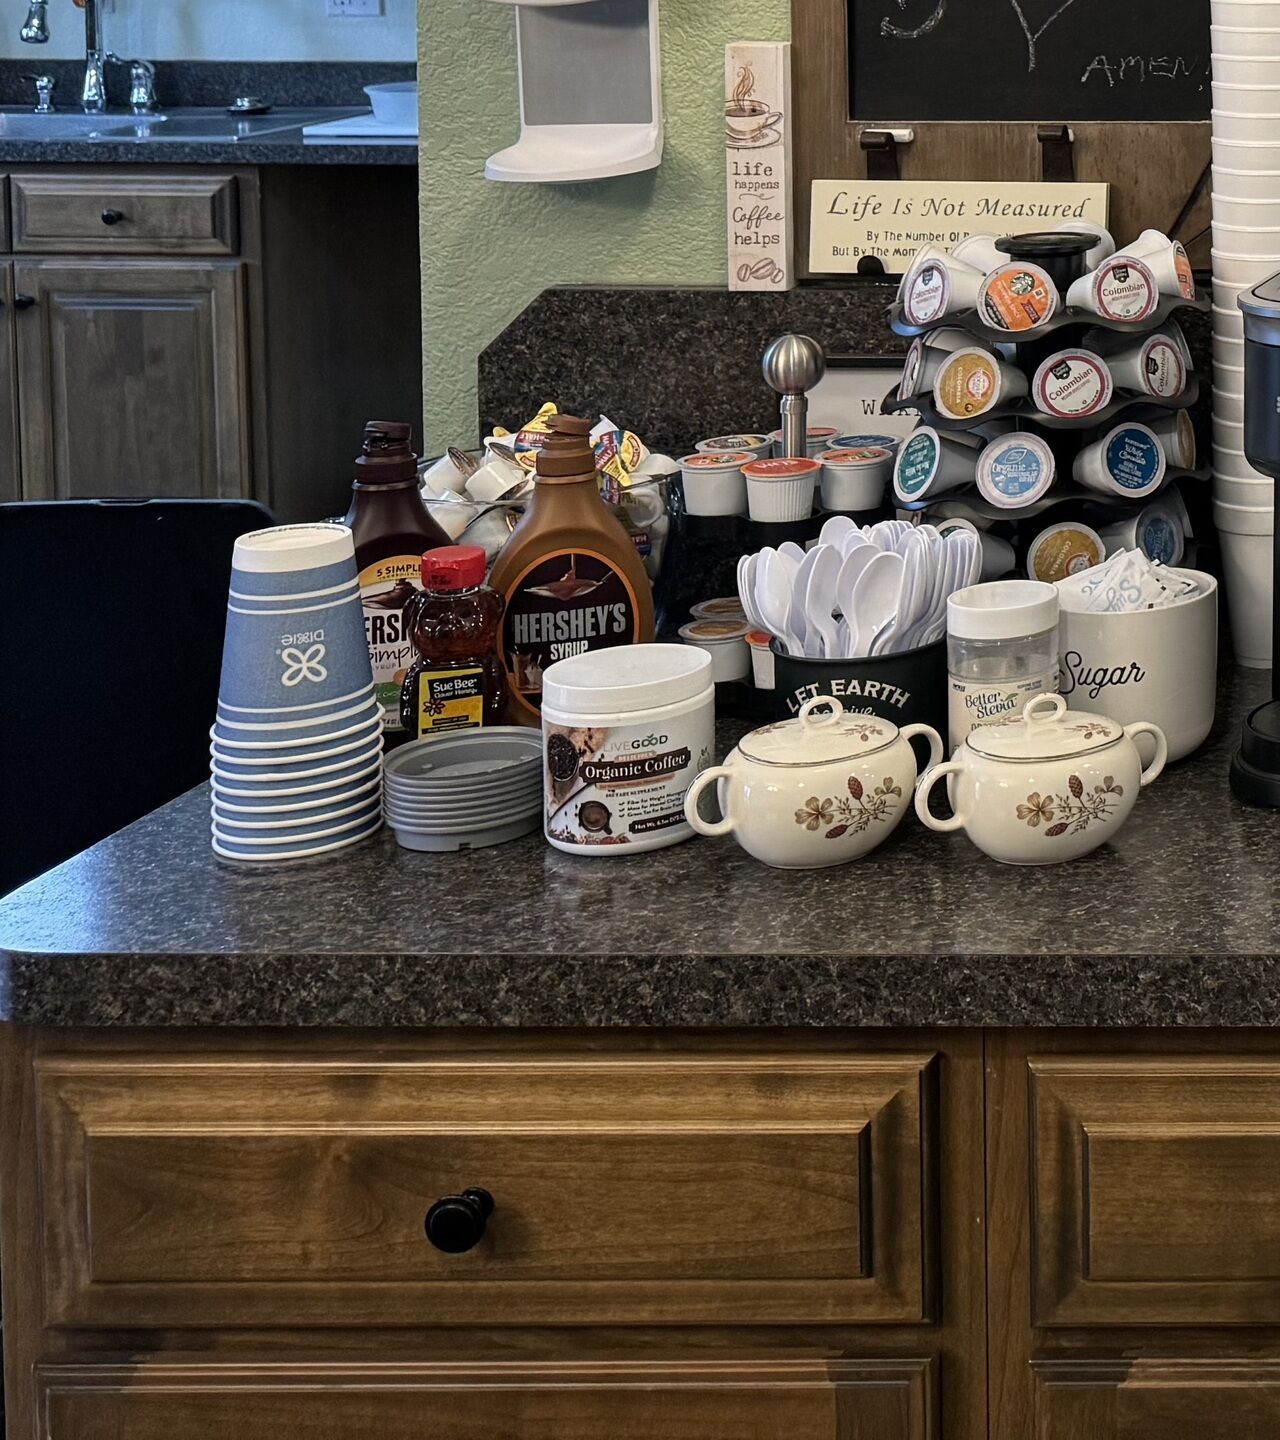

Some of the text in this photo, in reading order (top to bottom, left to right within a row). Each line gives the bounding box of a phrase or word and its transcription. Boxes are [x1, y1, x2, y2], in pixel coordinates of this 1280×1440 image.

[732, 161, 773, 177] life
[734, 179, 780, 191] happens
[826, 191, 1091, 221] Life Is Not Measured
[732, 205, 785, 230] Coffee
[734, 232, 780, 248] helps
[866, 230, 880, 244] By
[884, 230, 903, 241] The
[905, 231, 945, 242] Number
[949, 232, 960, 242] Of
[832, 245, 850, 256] But
[870, 247, 889, 257] The
[1102, 282, 1146, 297] Colombian
[1157, 347, 1167, 393] Colombian
[1049, 366, 1094, 401] Colombian
[1049, 540, 1072, 575] COLOMBIA
[376, 568, 383, 577] 5
[384, 563, 422, 575] SIMPLE
[513, 603, 626, 644] HERSHEY'S
[550, 640, 589, 660] SYRUP
[432, 678, 475, 692] Sue Bee
[1059, 650, 1146, 700] Sugar
[786, 679, 912, 714] LET EARTH
[964, 692, 1001, 709] Better
[976, 699, 1017, 719] Stevia
[585, 754, 686, 780] Organic Coffee
